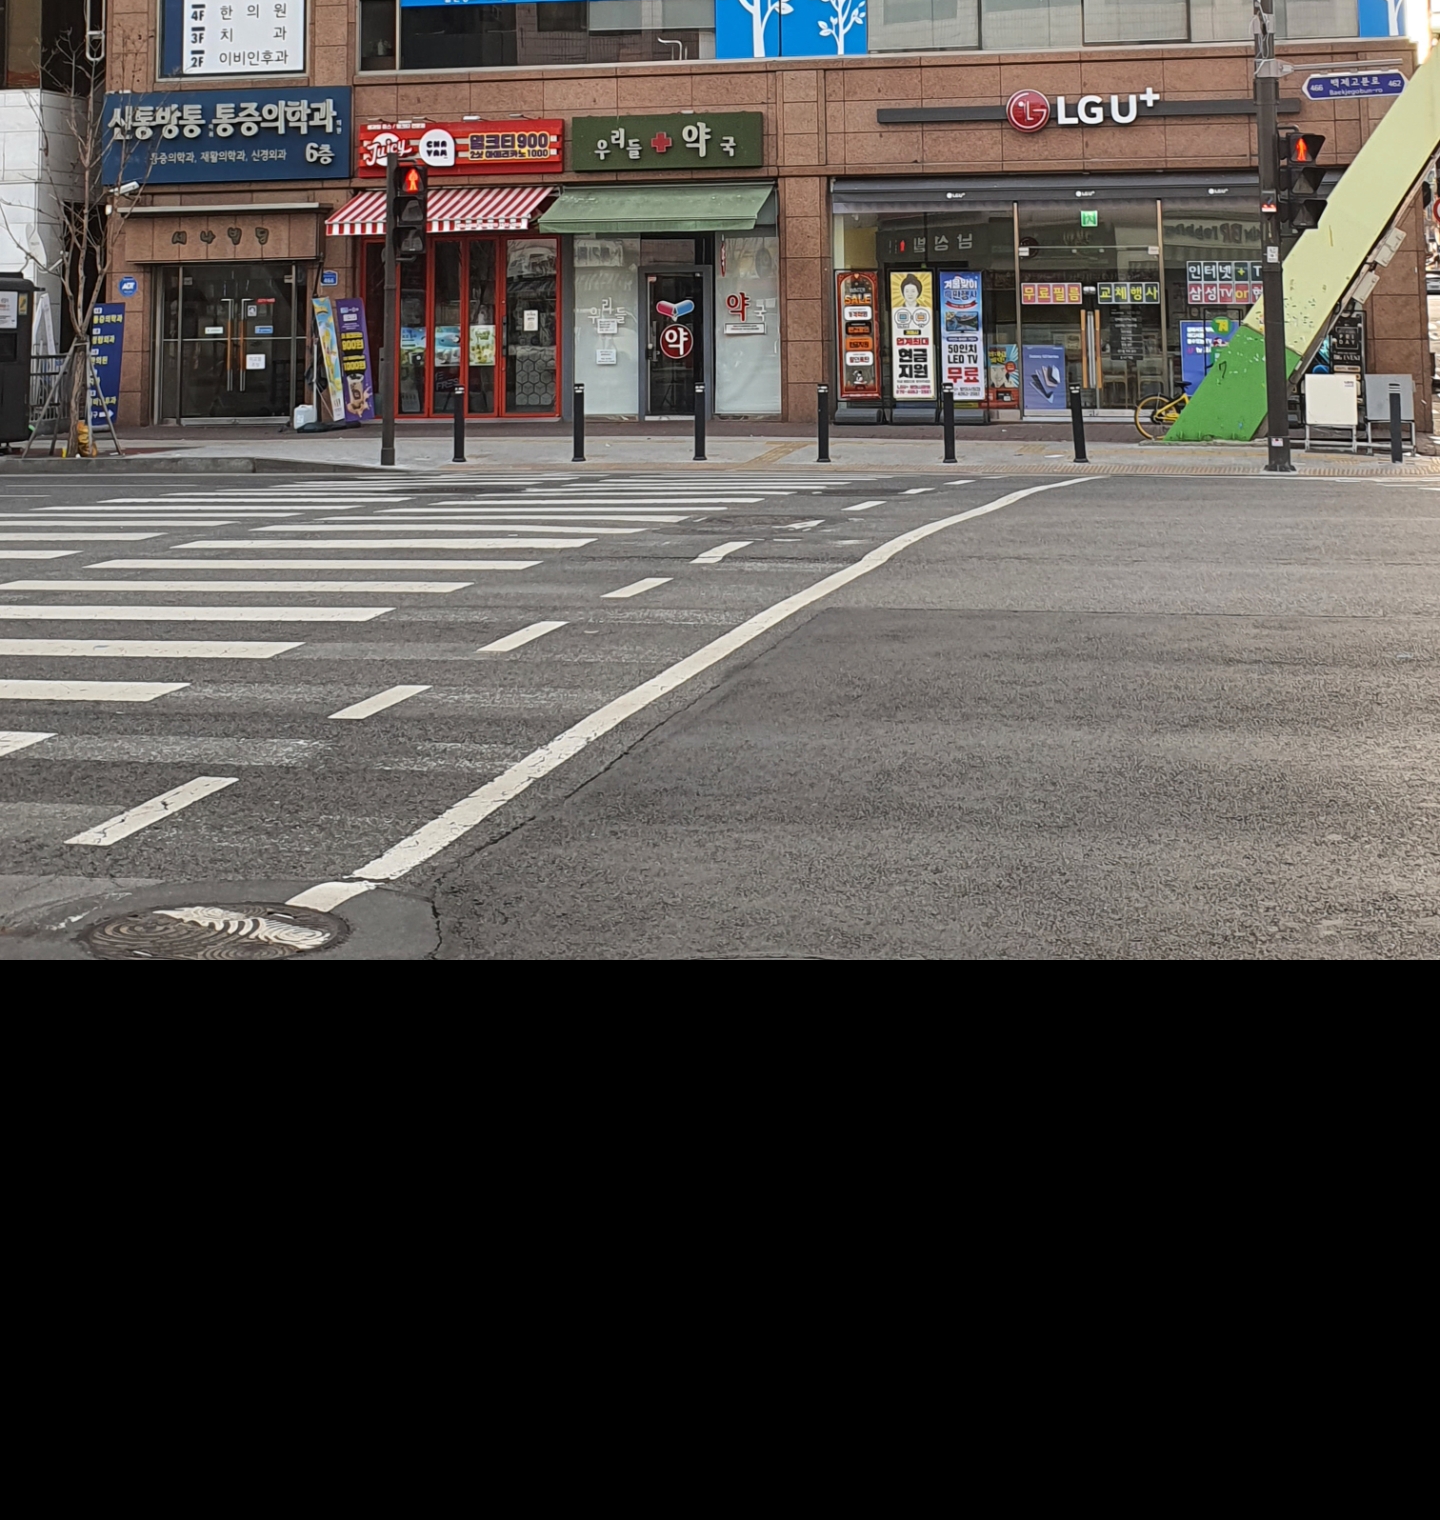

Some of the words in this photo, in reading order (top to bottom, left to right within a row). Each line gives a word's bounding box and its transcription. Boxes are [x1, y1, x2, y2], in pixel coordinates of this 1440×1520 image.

[191, 10, 205, 21] 4F
[191, 33, 204, 44] 3F
[190, 57, 204, 68] 2F
[219, 50, 289, 67] 이비인후과
[1310, 83, 1324, 92] 466
[1330, 76, 1381, 88] 백제고분로
[1388, 79, 1402, 88] 462
[1329, 87, 1383, 97] Baekjegobun-ro
[211, 98, 337, 137] 통증의학과
[469, 134, 515, 150] 밀크티
[517, 132, 549, 149] 900
[594, 127, 643, 161] 우리들
[682, 121, 737, 158] 약국
[251, 148, 287, 161] 신경외과
[305, 142, 335, 165] 6층
[527, 148, 549, 158] 1000
[1188, 264, 1231, 280] 인터넷
[844, 294, 871, 305] SALE
[1023, 286, 1081, 301] 무료필름
[1100, 286, 1158, 300] 교체행사
[1236, 288, 1250, 298] or
[664, 327, 689, 355] 약
[948, 344, 977, 354] 50인치
[948, 354, 964, 364] LED
[968, 354, 977, 364] TV
[899, 365, 928, 378] 지원
[947, 367, 979, 383] 무료
